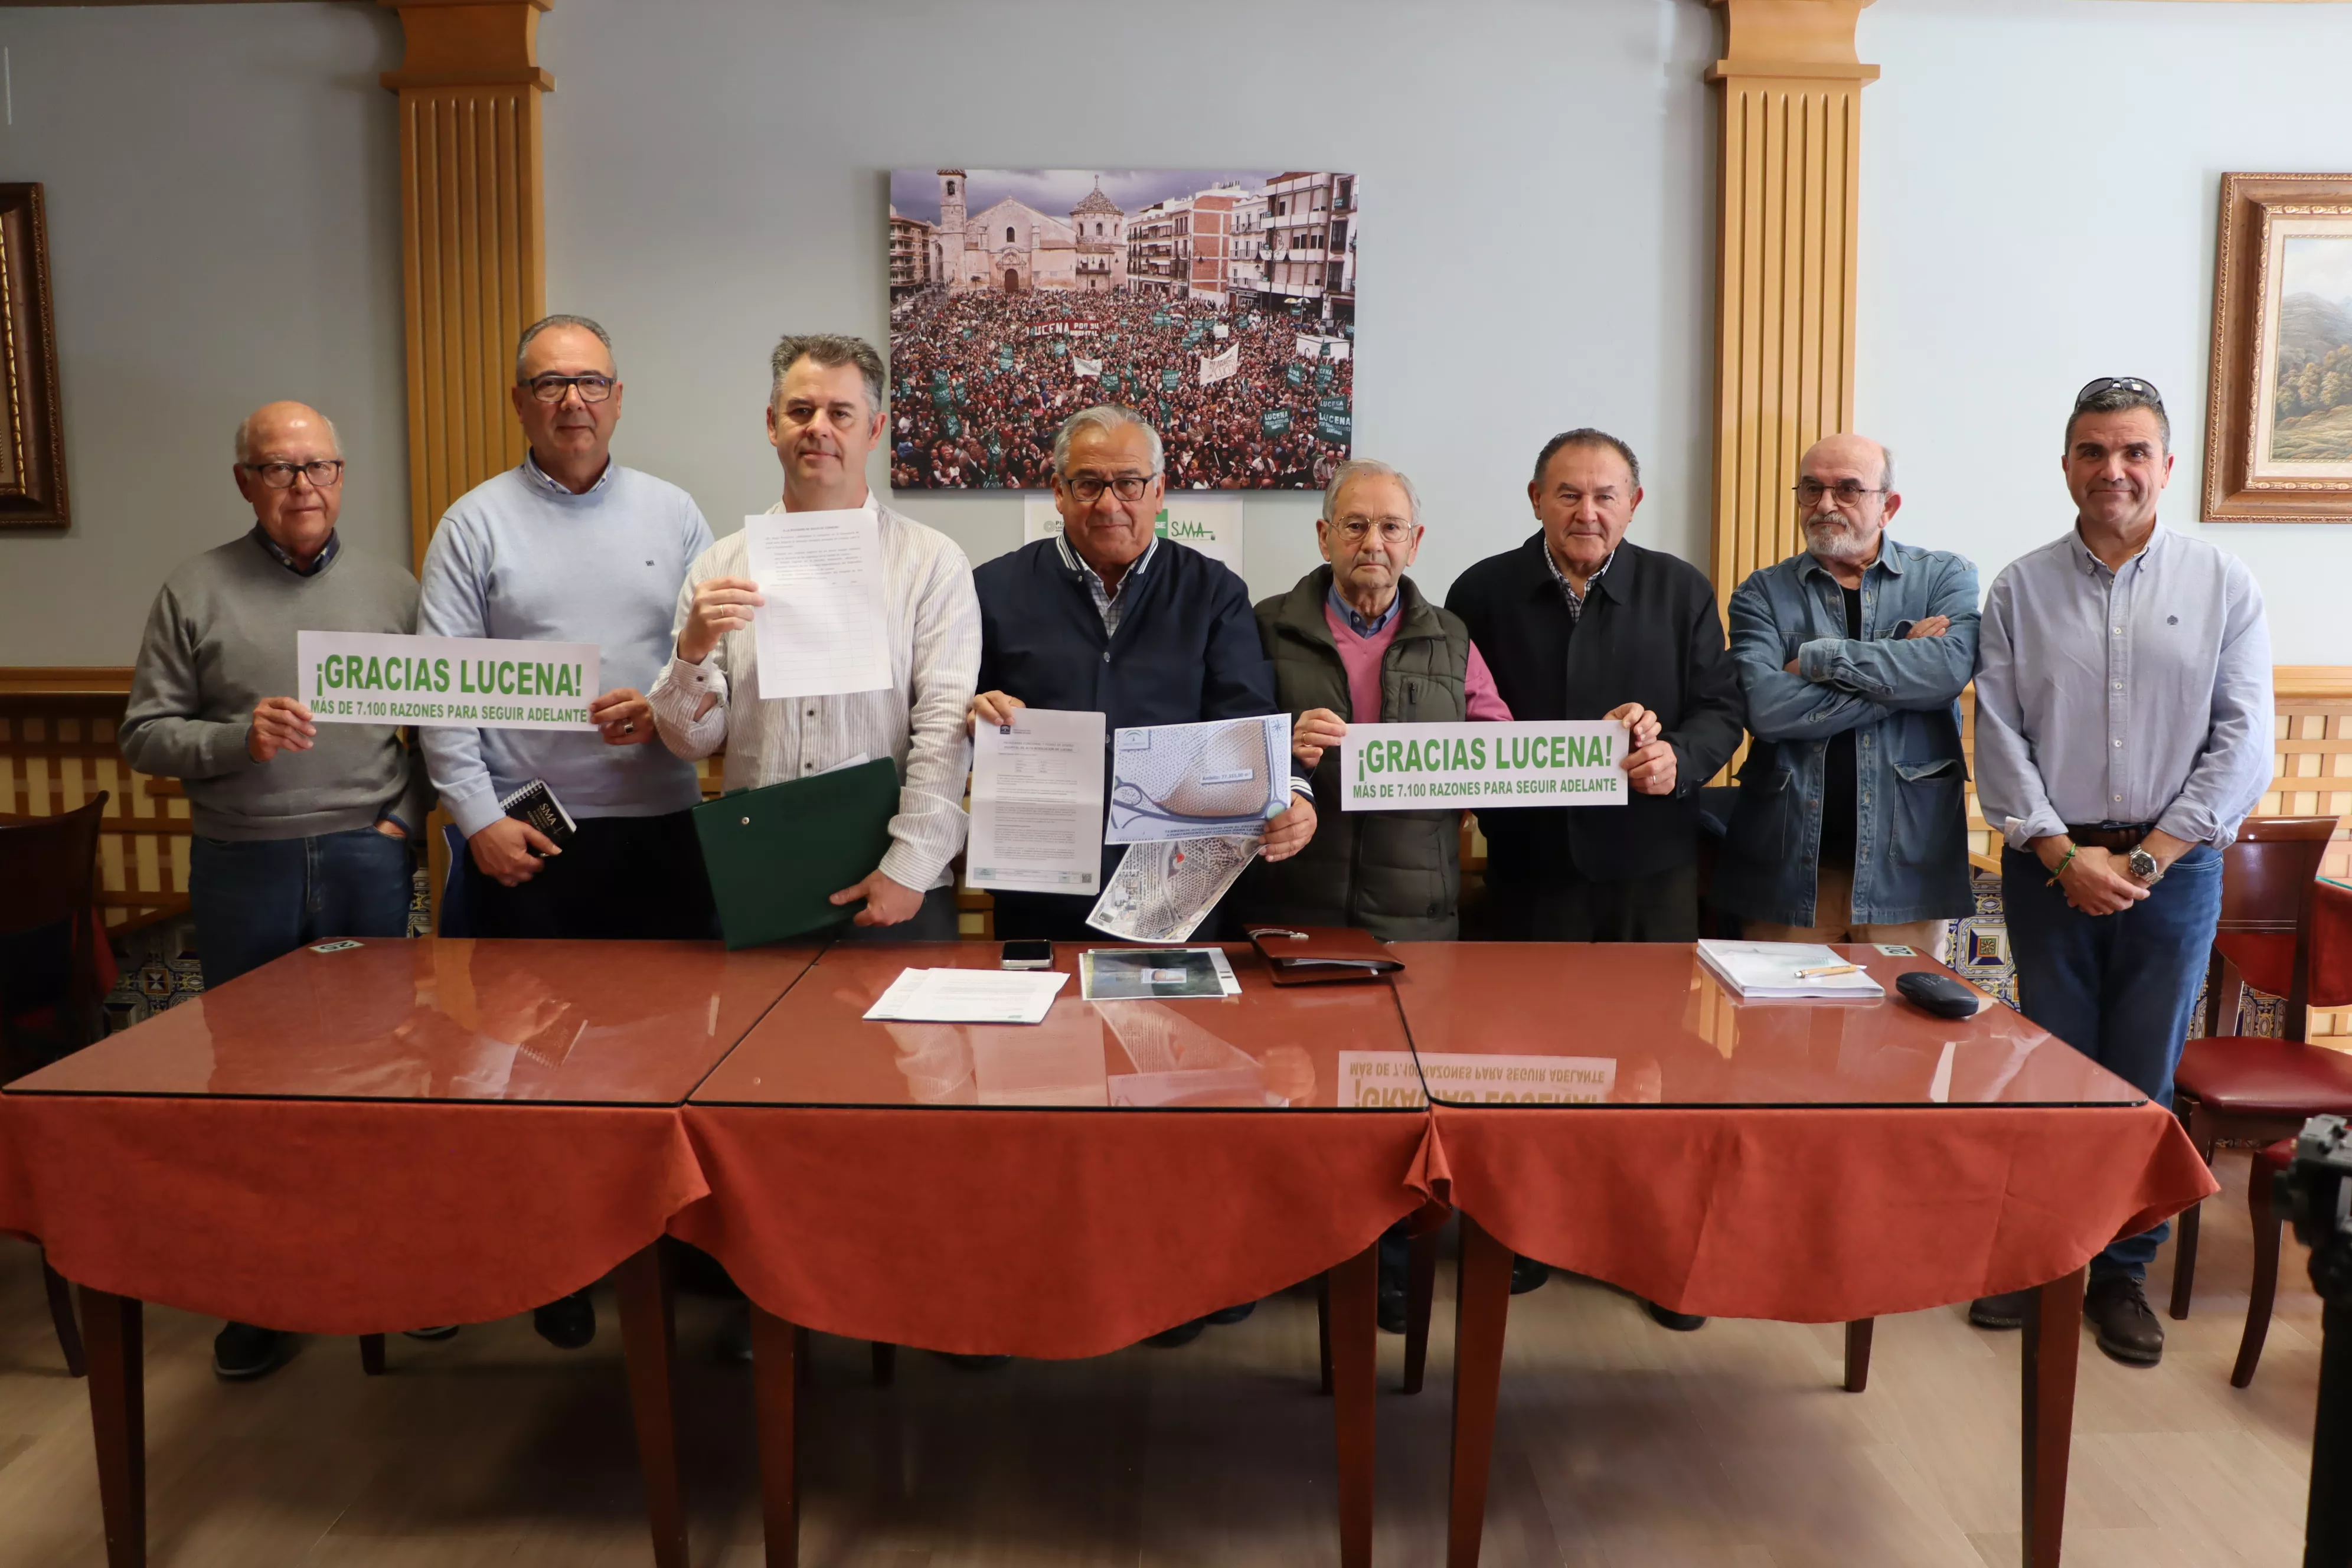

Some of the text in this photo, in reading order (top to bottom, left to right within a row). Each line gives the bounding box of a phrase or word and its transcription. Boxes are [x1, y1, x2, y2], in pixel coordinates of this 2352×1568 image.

[1265, 410, 1288, 420] LUCENA
[1319, 412, 1351, 426] LUCENA
[316, 654, 582, 696] ¡GRACIAS LUCENA!
[311, 697, 587, 723] MÁS DE 7.100 RAZONES PARA SEGUIR ADELANTE
[1358, 735, 1613, 782] ¡GRACIAS LUCENA!
[1353, 778, 1617, 799] MÁS DE 7.100 RAZONES PARA SEGUIR ADELANTE
[540, 803, 557, 825] SMA
[1884, 946, 1912, 955] 20
